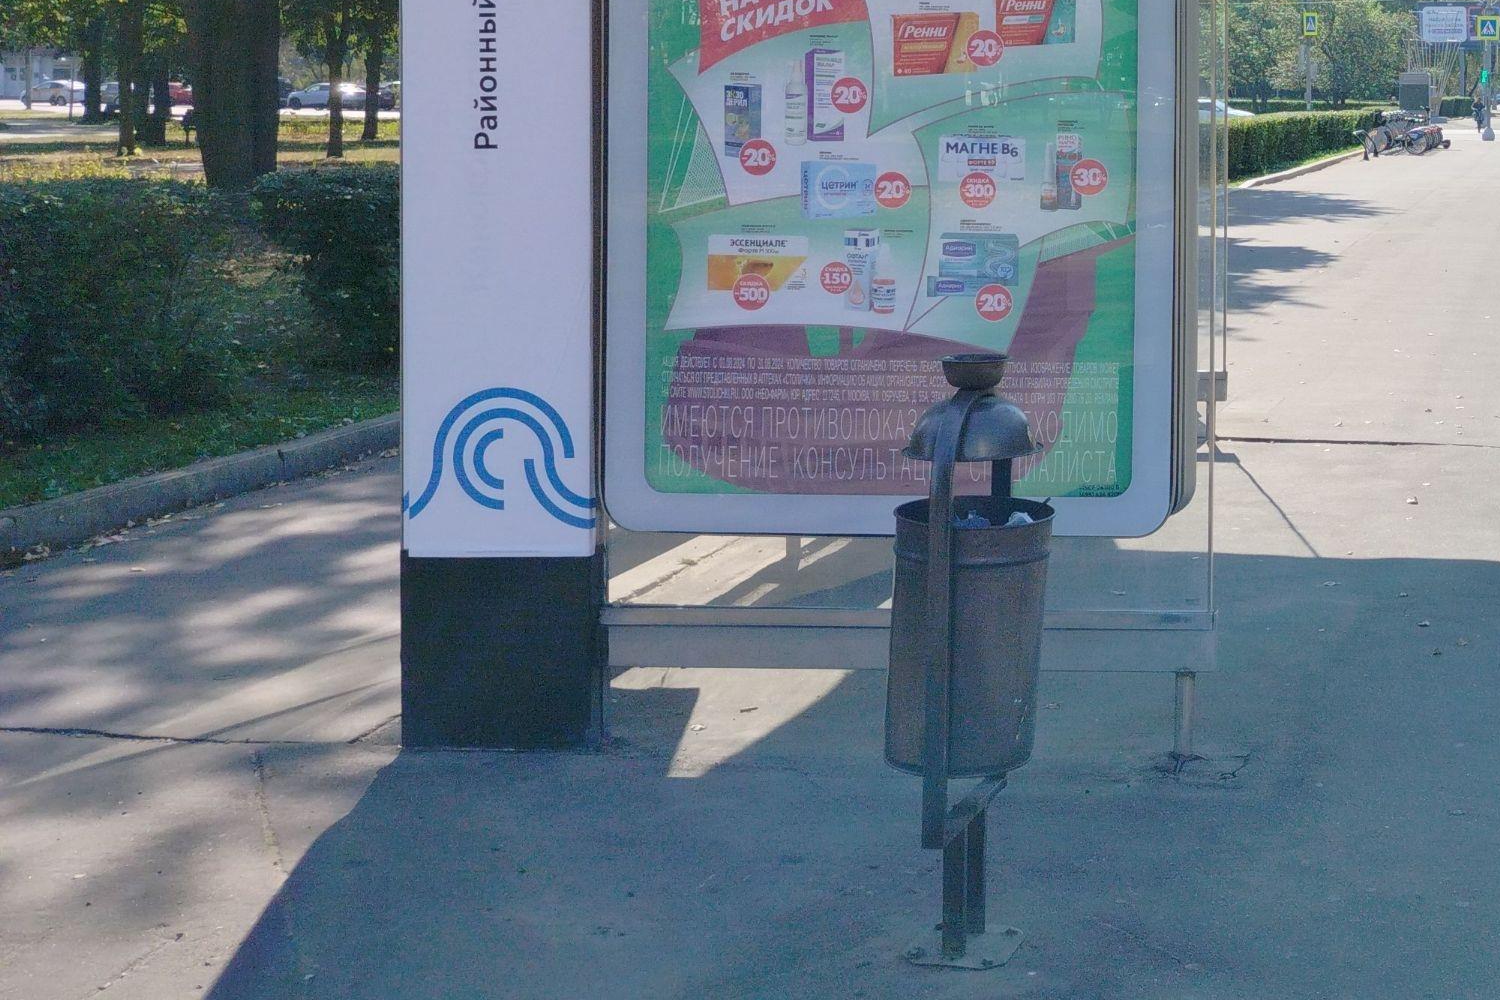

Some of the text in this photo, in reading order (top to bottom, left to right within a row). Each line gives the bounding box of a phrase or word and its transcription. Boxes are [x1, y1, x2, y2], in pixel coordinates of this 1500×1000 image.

[945, 141, 998, 155] МАГНЕ
[660, 406, 919, 442] ИМЕЮТСЯ ПРОТИВОПОКАЗ
[1024, 410, 1118, 448] ХОДИМО
[658, 444, 932, 485] ПОЛУЧЕНИЕ КОНСУЛЬТАЦ
